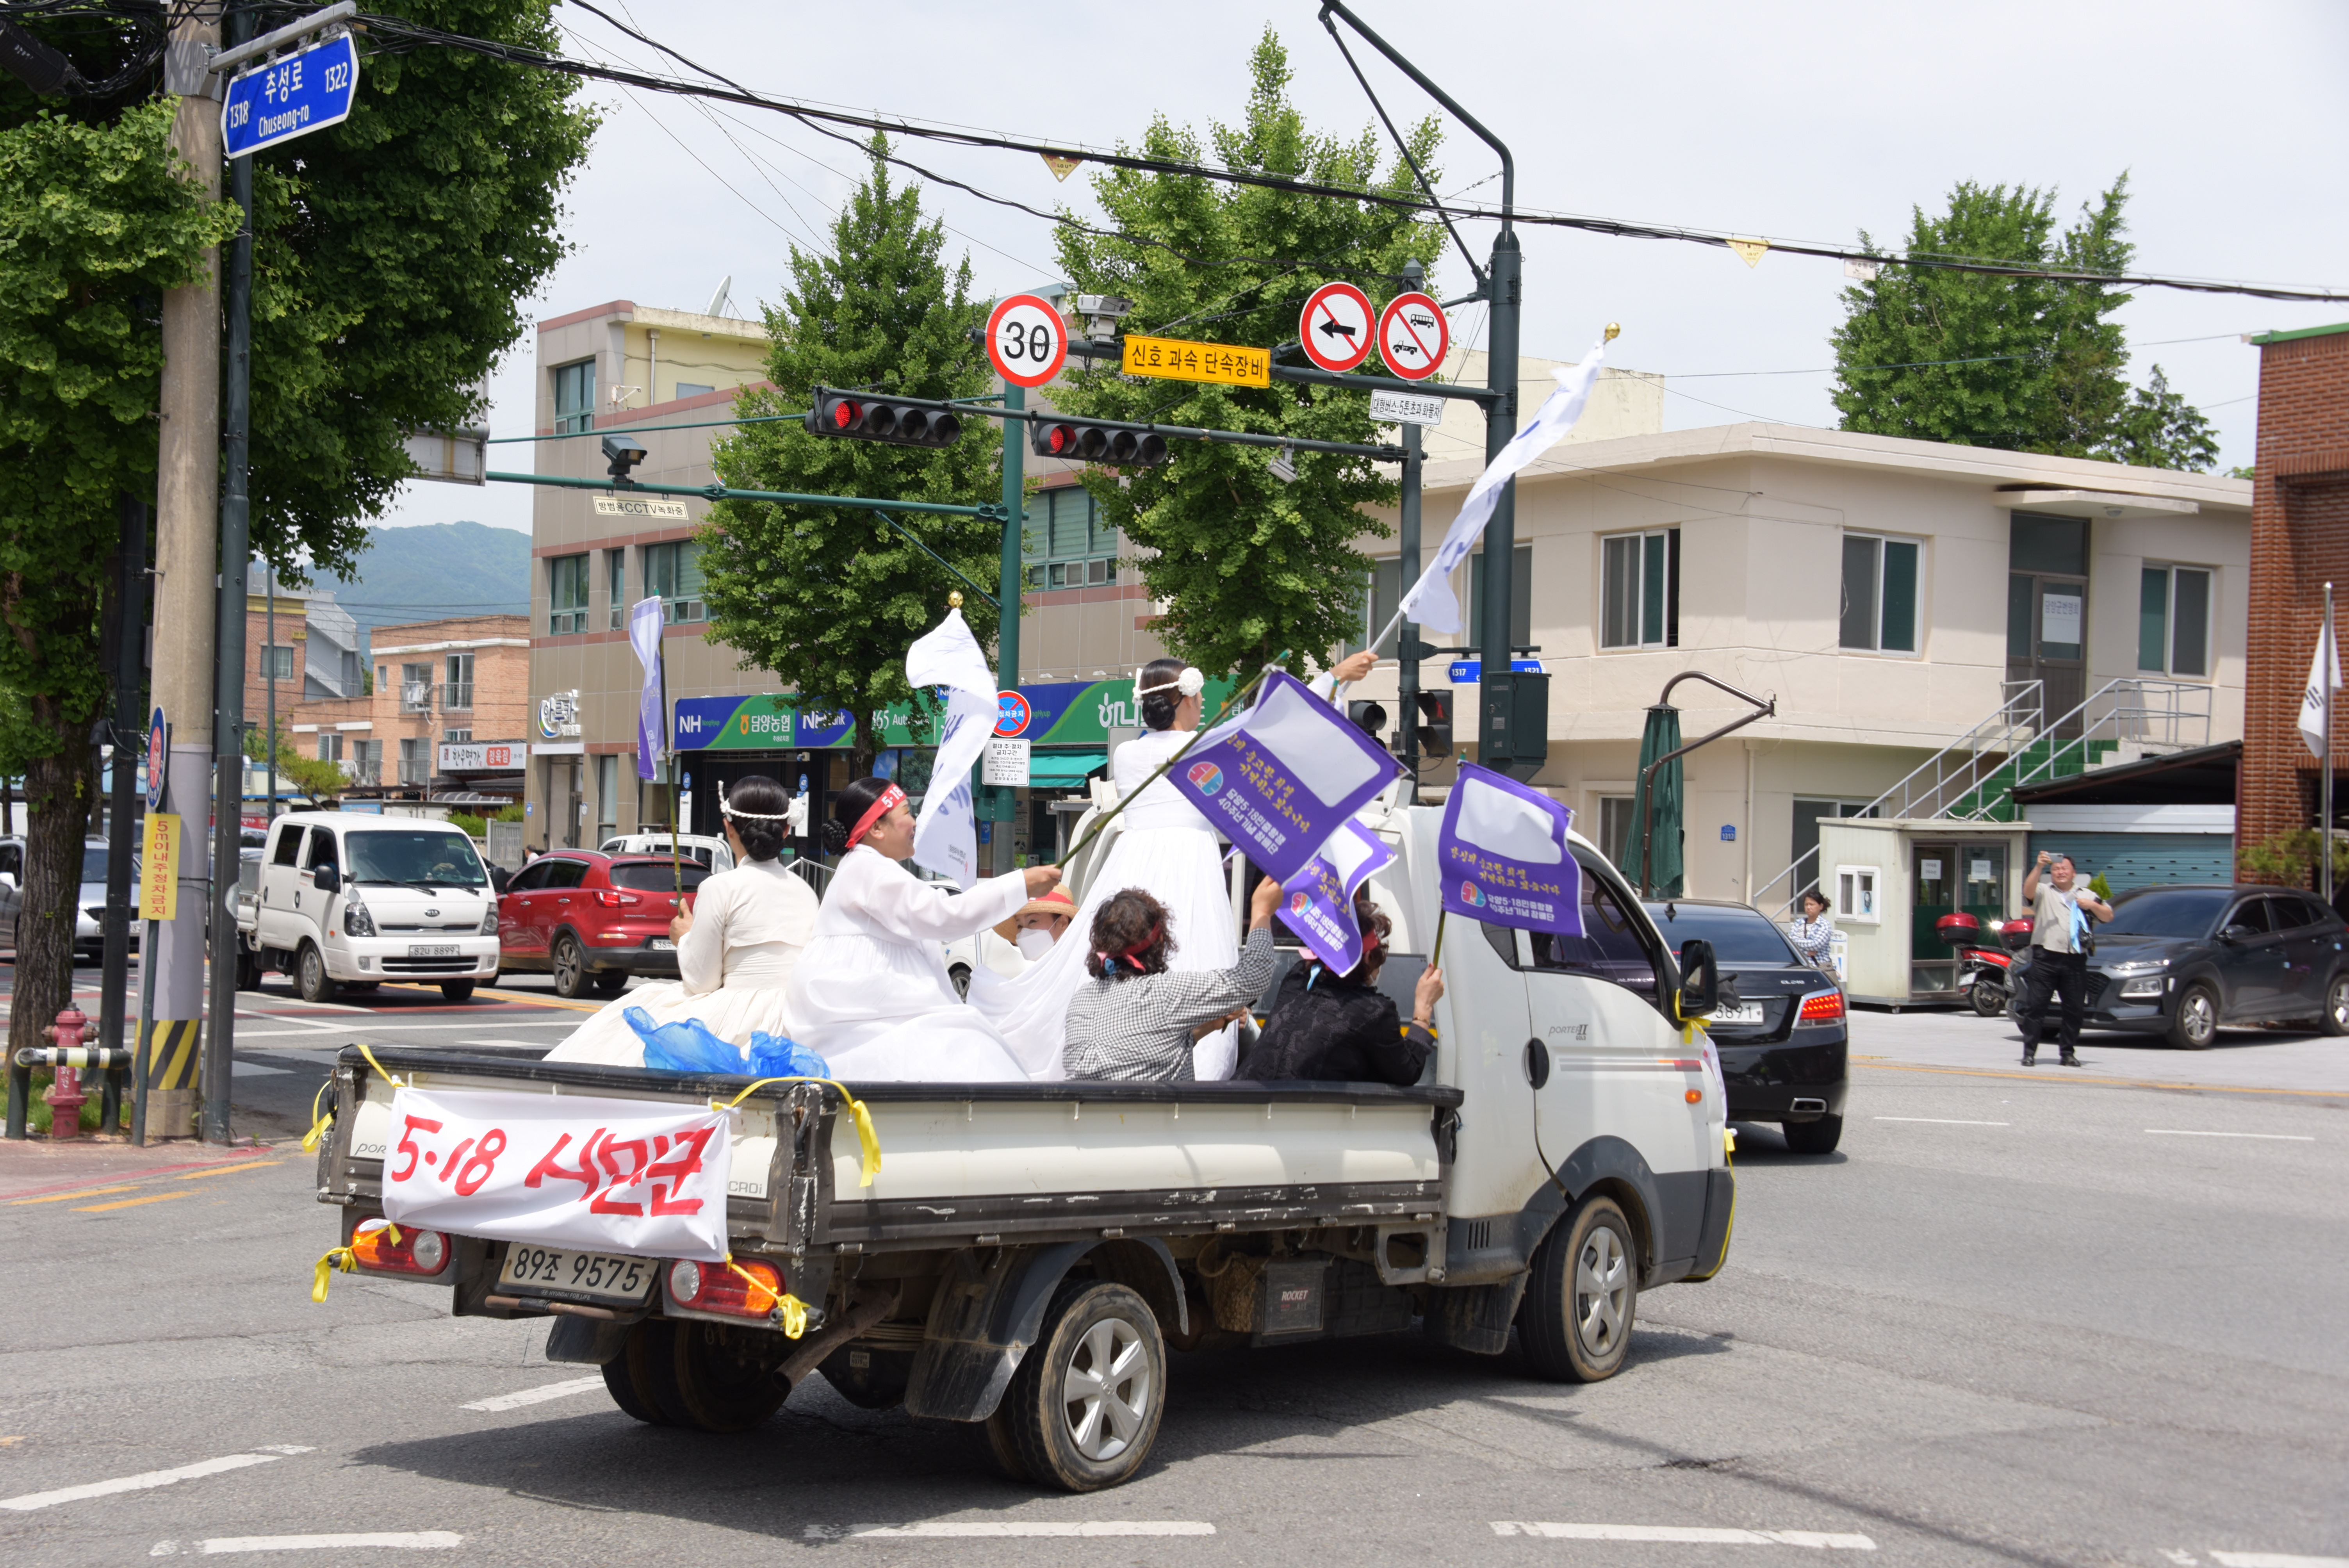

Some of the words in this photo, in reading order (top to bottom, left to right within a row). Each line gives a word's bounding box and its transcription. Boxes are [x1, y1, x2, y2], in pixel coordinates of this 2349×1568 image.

[266, 61, 303, 103] 추성로
[325, 62, 348, 93] 1322
[230, 100, 249, 128] 1318
[259, 105, 309, 137] Chuseong-ro
[1005, 322, 1050, 362] 30
[1132, 344, 1162, 367] 신호
[1168, 348, 1198, 372] 과속
[1205, 352, 1263, 379] 단속장비
[598, 501, 683, 516] 방범용CCTV녹화중
[751, 714, 790, 732] 담양농협
[998, 710, 1024, 718] 정차금지
[1031, 709, 1051, 719] ngHyup
[679, 715, 701, 733] NH
[453, 747, 481, 766] 한우명가
[489, 749, 508, 764] 정육점
[434, 946, 455, 955] 8899
[354, 1142, 387, 1156] POR
[524, 1126, 718, 1218] 시민군
[728, 1181, 763, 1195] CRDi
[514, 1248, 563, 1281] 89조
[570, 1254, 645, 1292] 9575
[1281, 1290, 1308, 1301] ROCKET
